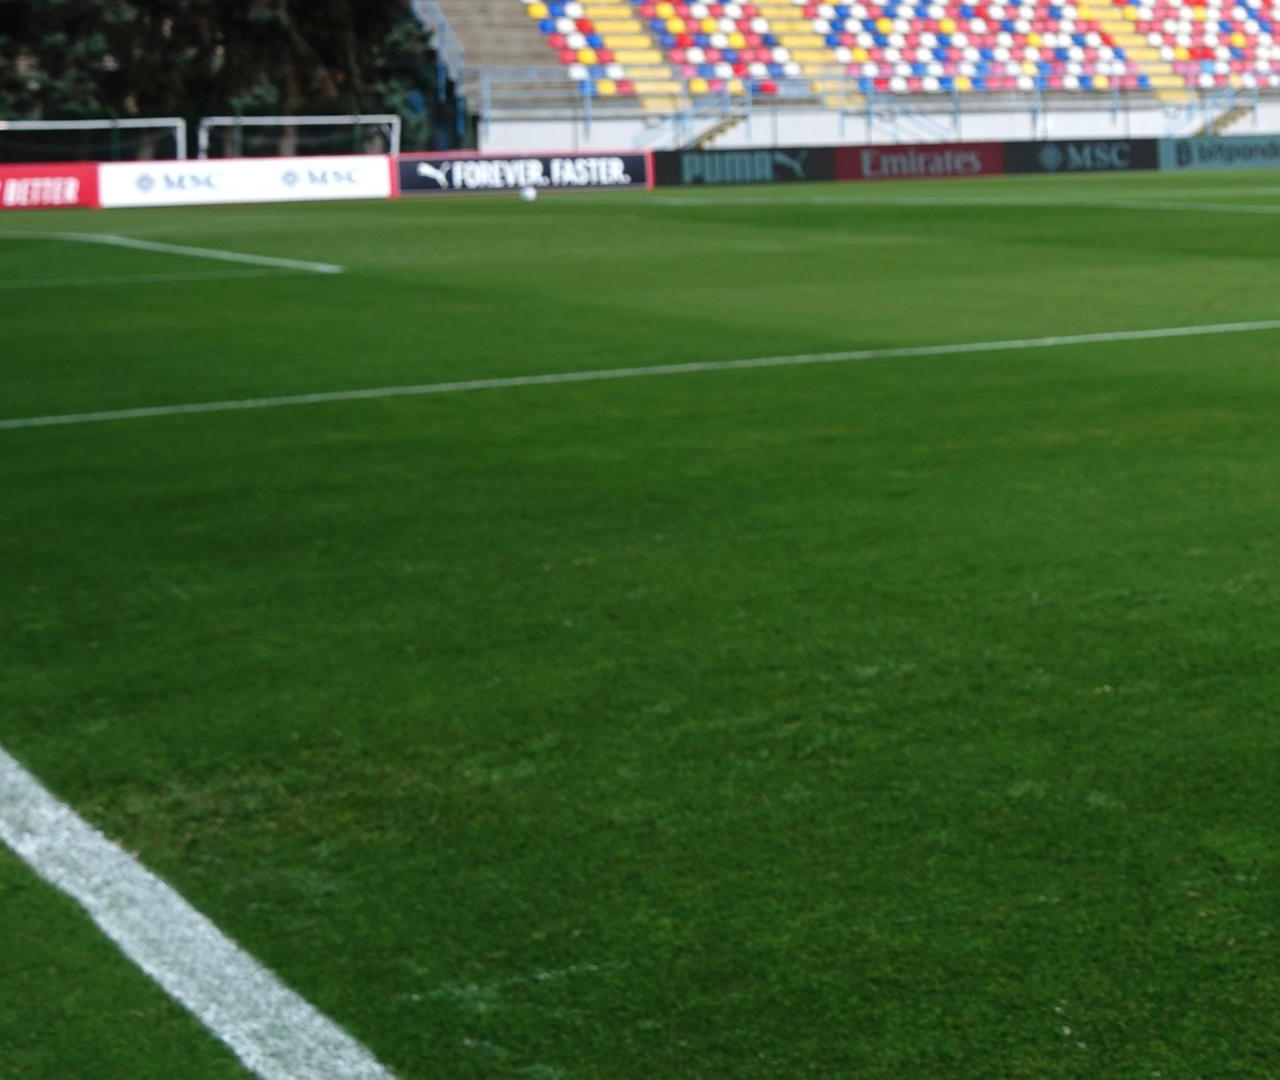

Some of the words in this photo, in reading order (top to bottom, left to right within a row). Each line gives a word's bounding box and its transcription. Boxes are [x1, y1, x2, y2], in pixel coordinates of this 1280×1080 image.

[860, 149, 982, 178] Emirates
[1066, 143, 1131, 169] MSC
[452, 159, 549, 189] FOREVER.
[550, 157, 631, 186] FASTER.
